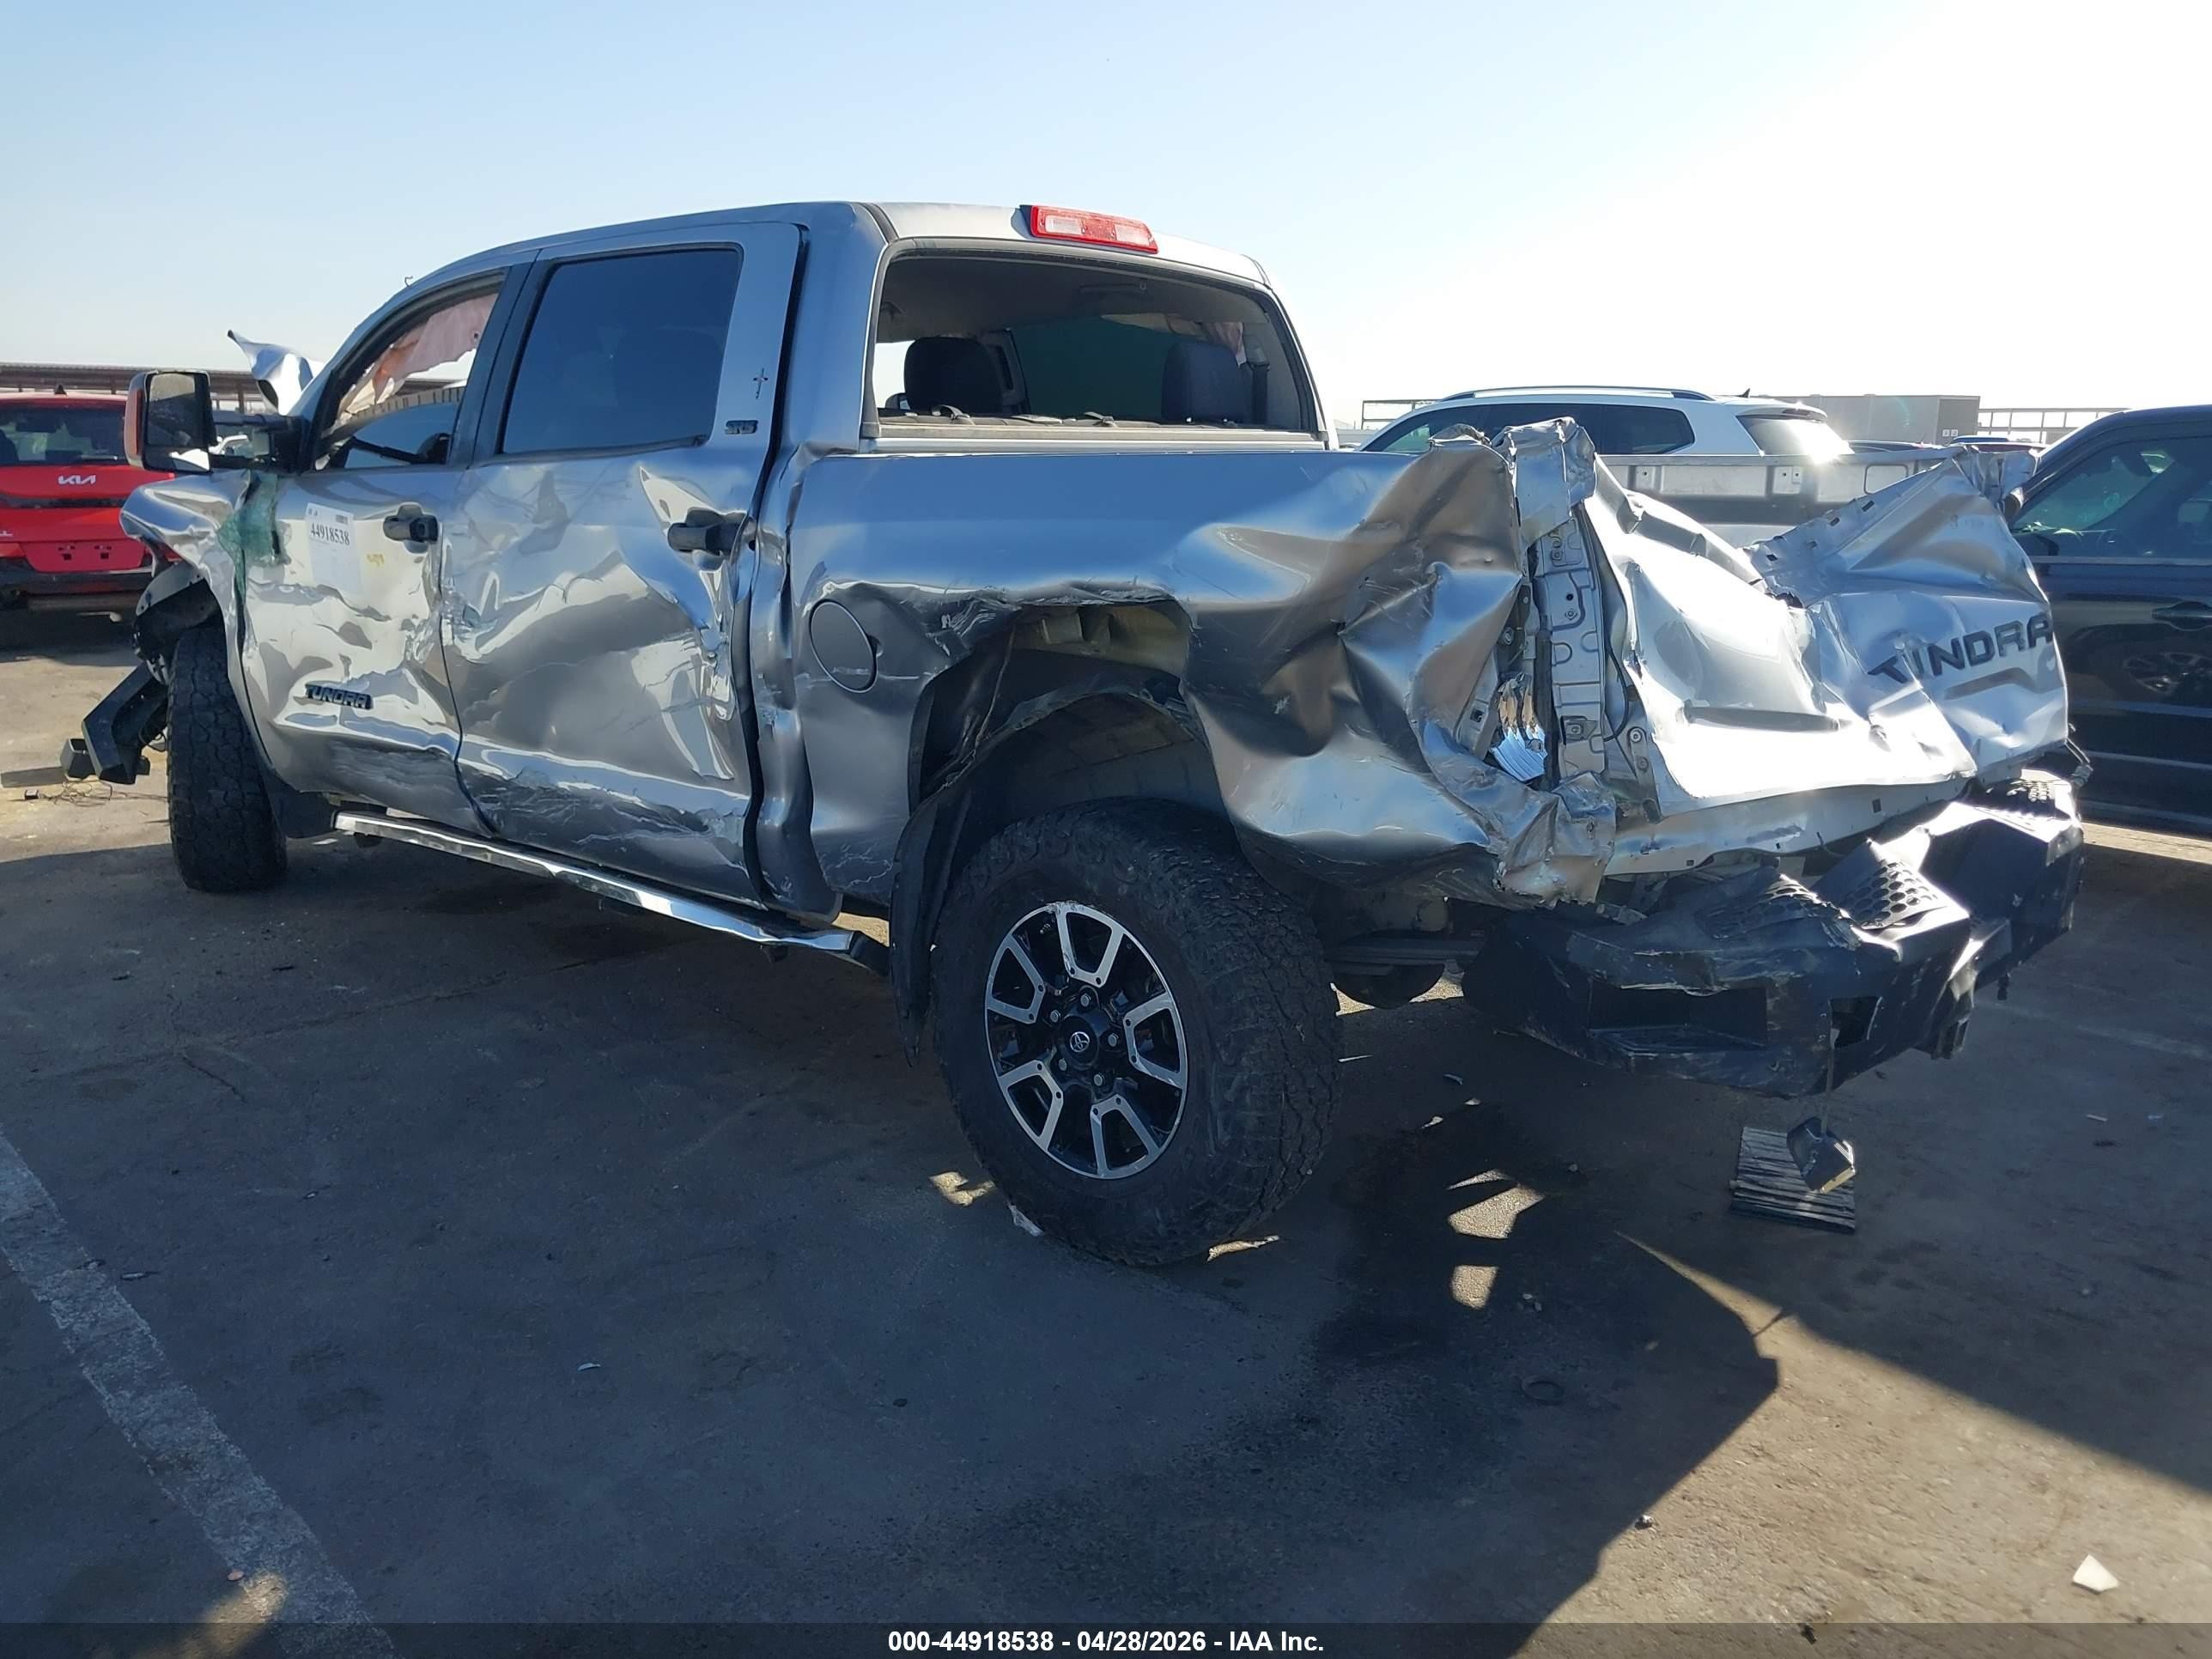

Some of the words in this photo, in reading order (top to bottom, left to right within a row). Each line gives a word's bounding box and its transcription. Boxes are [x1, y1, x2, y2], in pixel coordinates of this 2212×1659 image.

[58, 474, 96, 484] KIA
[311, 522, 349, 546] 44918538
[305, 684, 373, 709] TUNDRA
